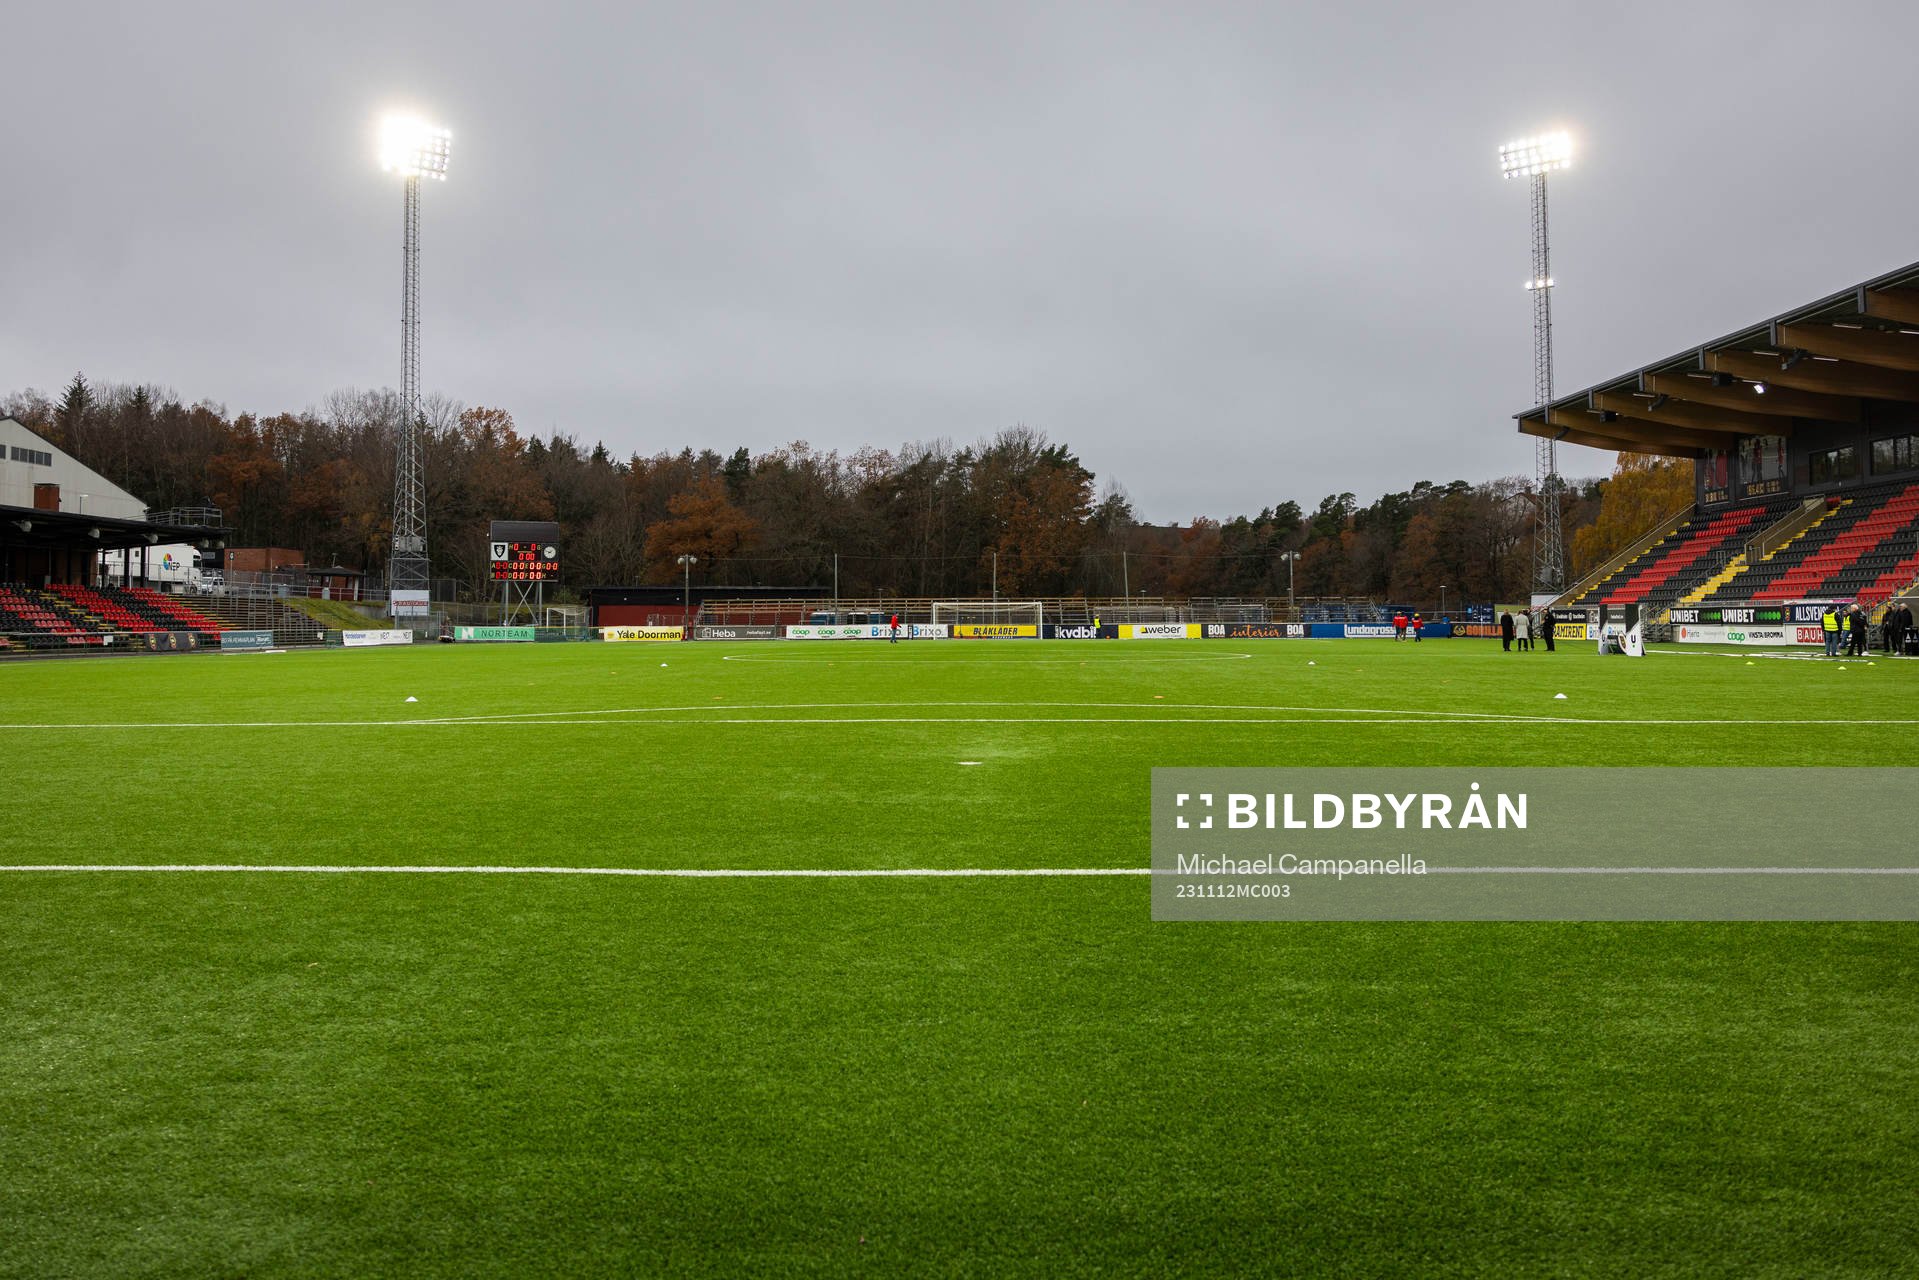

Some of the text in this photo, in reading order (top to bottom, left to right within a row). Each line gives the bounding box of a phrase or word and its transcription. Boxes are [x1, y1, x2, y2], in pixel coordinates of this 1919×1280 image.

[1670, 609, 1699, 623] UNIBET
[1722, 608, 1755, 623] UNIBET
[481, 629, 528, 638] NORTEAM
[712, 629, 736, 637] Heba
[792, 626, 810, 635] coop
[817, 626, 836, 635] coop
[843, 626, 861, 635] coop
[1147, 625, 1182, 634] weber
[1208, 624, 1226, 635] BOA
[1286, 624, 1305, 635] BOA
[1466, 624, 1504, 636] GORILLA
[616, 630, 681, 639] Yale Doorman
[1797, 628, 1824, 641] BAUH
